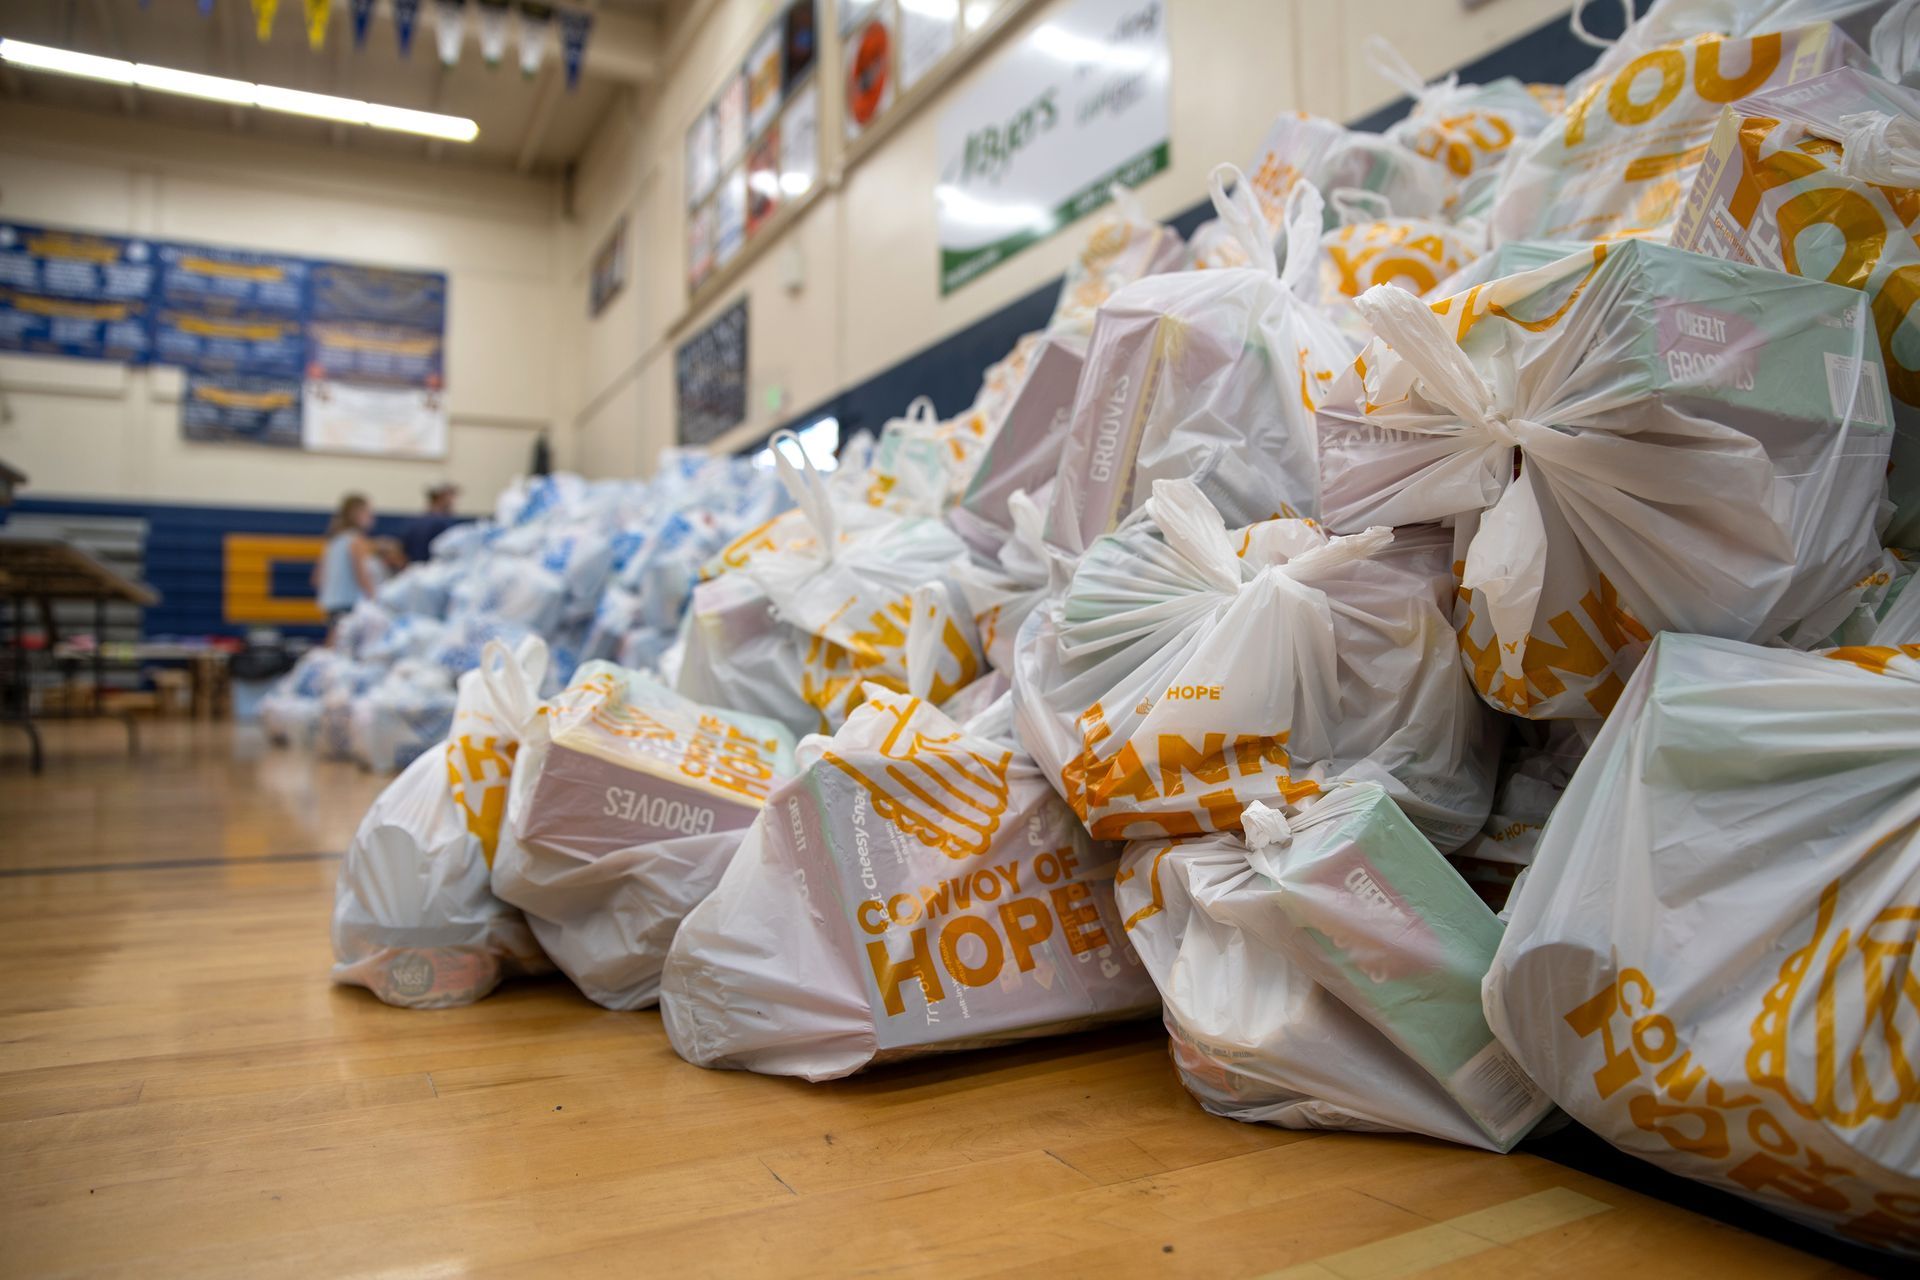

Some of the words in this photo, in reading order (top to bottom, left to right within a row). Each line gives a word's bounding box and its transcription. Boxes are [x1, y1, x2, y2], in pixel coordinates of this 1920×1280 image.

[1090, 375, 1130, 482] GROOVES
[1166, 685, 1222, 700] HOPE
[603, 786, 715, 836] GROOVES
[855, 828, 878, 889] Cheesy
[857, 860, 1022, 935] CONVOY
[1033, 846, 1080, 885] OF
[866, 880, 1110, 1018] HOPE
